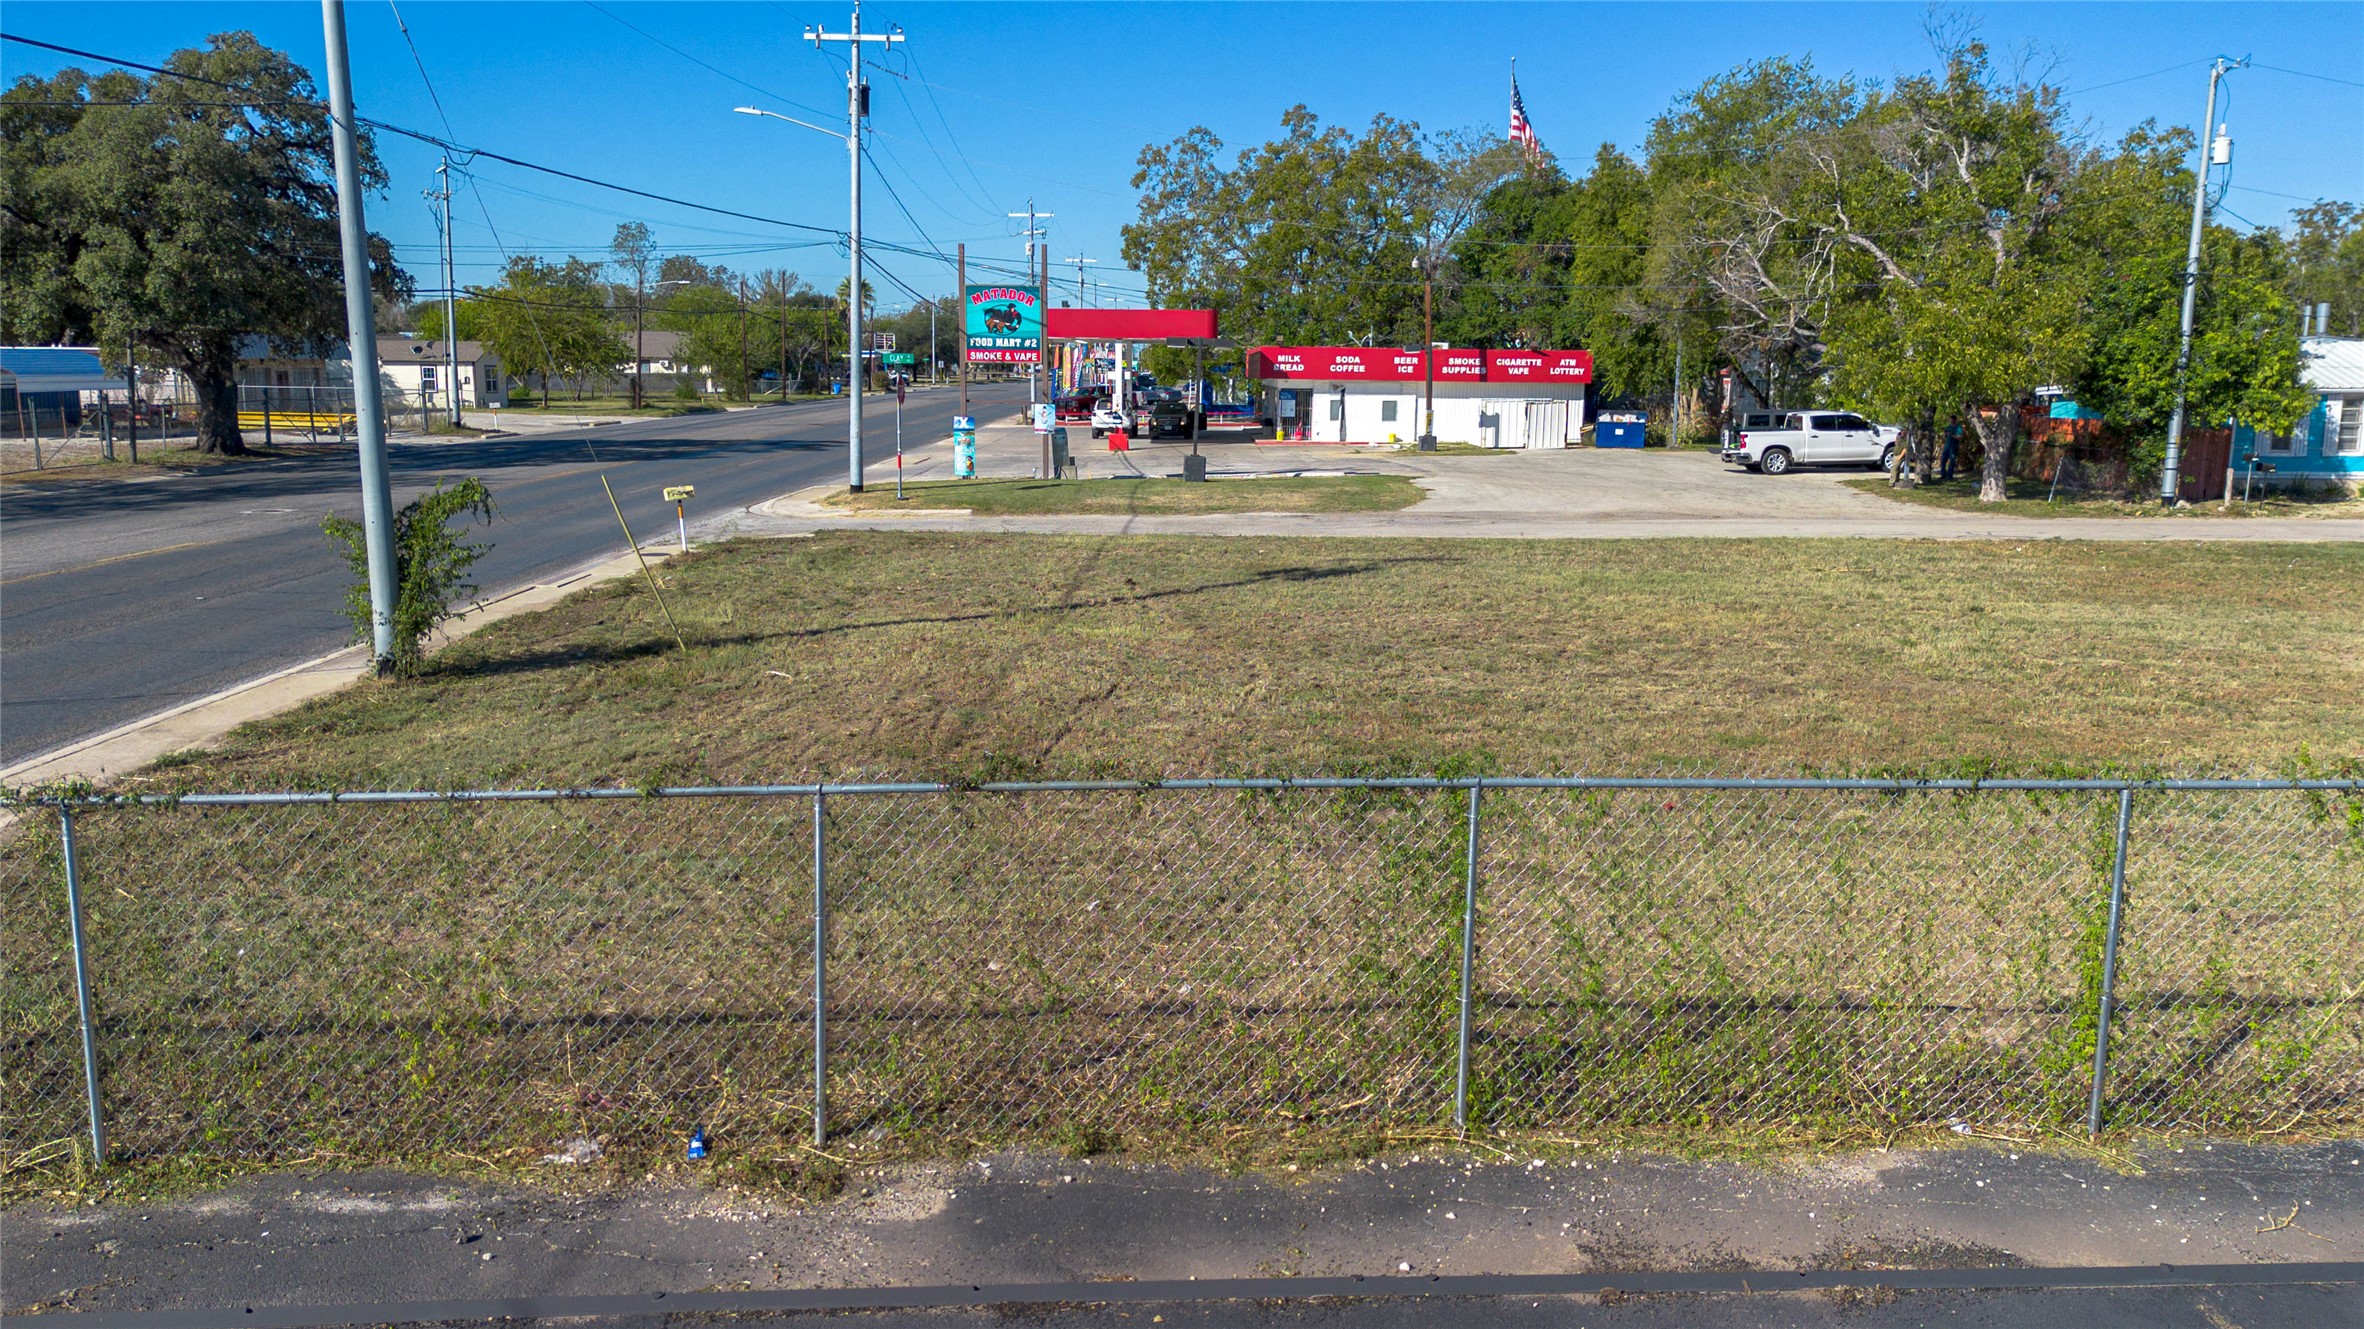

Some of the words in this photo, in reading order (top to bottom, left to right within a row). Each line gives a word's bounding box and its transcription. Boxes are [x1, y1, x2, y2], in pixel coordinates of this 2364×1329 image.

[971, 288, 1035, 307] MATADOR
[970, 337, 993, 347] FOOD
[996, 338, 1021, 347] MART
[1024, 338, 1037, 348] #2
[890, 354, 903, 362] CLAY
[970, 351, 1002, 360] SMOKE
[1005, 352, 1011, 360] &
[1014, 352, 1037, 361] VAPE
[1277, 355, 1301, 363] MILK
[1335, 356, 1361, 364] SODA
[1393, 357, 1419, 365] BEER
[1448, 357, 1481, 365] SMOKE
[1496, 358, 1542, 366] CIGARETTE
[1559, 358, 1577, 367] ATM
[1329, 364, 1366, 373] COFFEE
[1398, 365, 1414, 373] ICE
[1441, 366, 1487, 374] SUPPLIES
[1508, 367, 1530, 375] VAPE
[1550, 367, 1585, 376] LOTTERY
